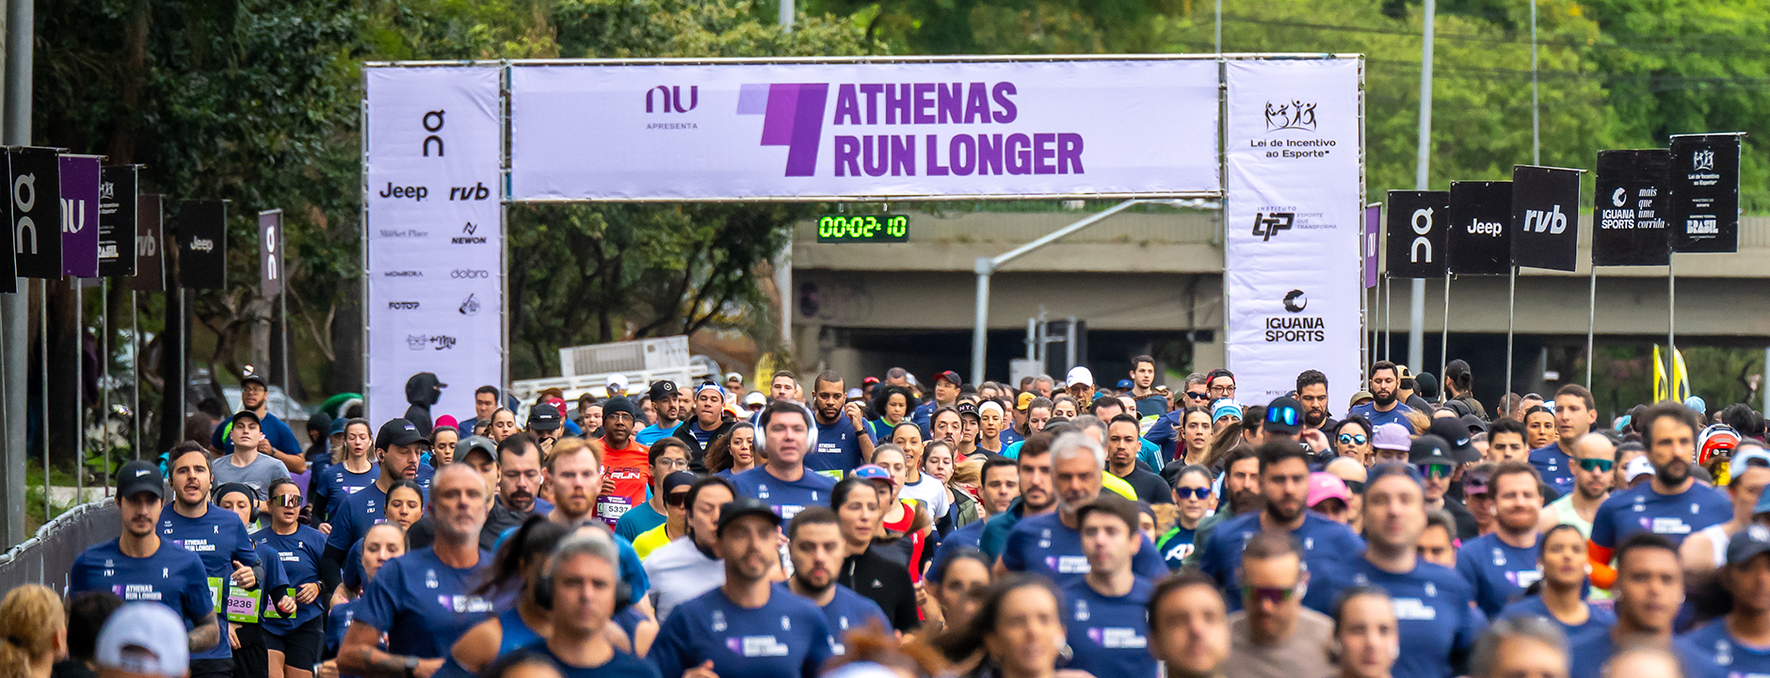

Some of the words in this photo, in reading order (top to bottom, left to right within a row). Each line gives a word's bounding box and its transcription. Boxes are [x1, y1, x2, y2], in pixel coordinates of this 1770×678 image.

[834, 81, 1017, 125] ATHENAS
[1250, 139, 1267, 147] Lei
[1270, 139, 1283, 147] de
[1286, 138, 1336, 147] Incentivo
[834, 134, 916, 177] RUN
[926, 132, 1085, 176] LONGER
[1265, 150, 1279, 158] ao
[380, 182, 428, 202] Jeep
[449, 181, 490, 201] rvb
[1638, 186, 1657, 197] mais
[1638, 199, 1653, 210] que
[1523, 204, 1567, 235] rvb
[1602, 209, 1635, 219] IGUANA
[1638, 210, 1655, 218] uma
[1467, 218, 1502, 238] Jeep
[1601, 219, 1635, 229] SPORTS
[1637, 218, 1665, 229] corrida
[1686, 220, 1719, 234] BRASIL
[190, 235, 213, 253] Jeep
[450, 268, 489, 279] dobro
[1265, 317, 1325, 329] IGUANA
[1265, 330, 1325, 342] SPORTS
[608, 505, 629, 513] 5337
